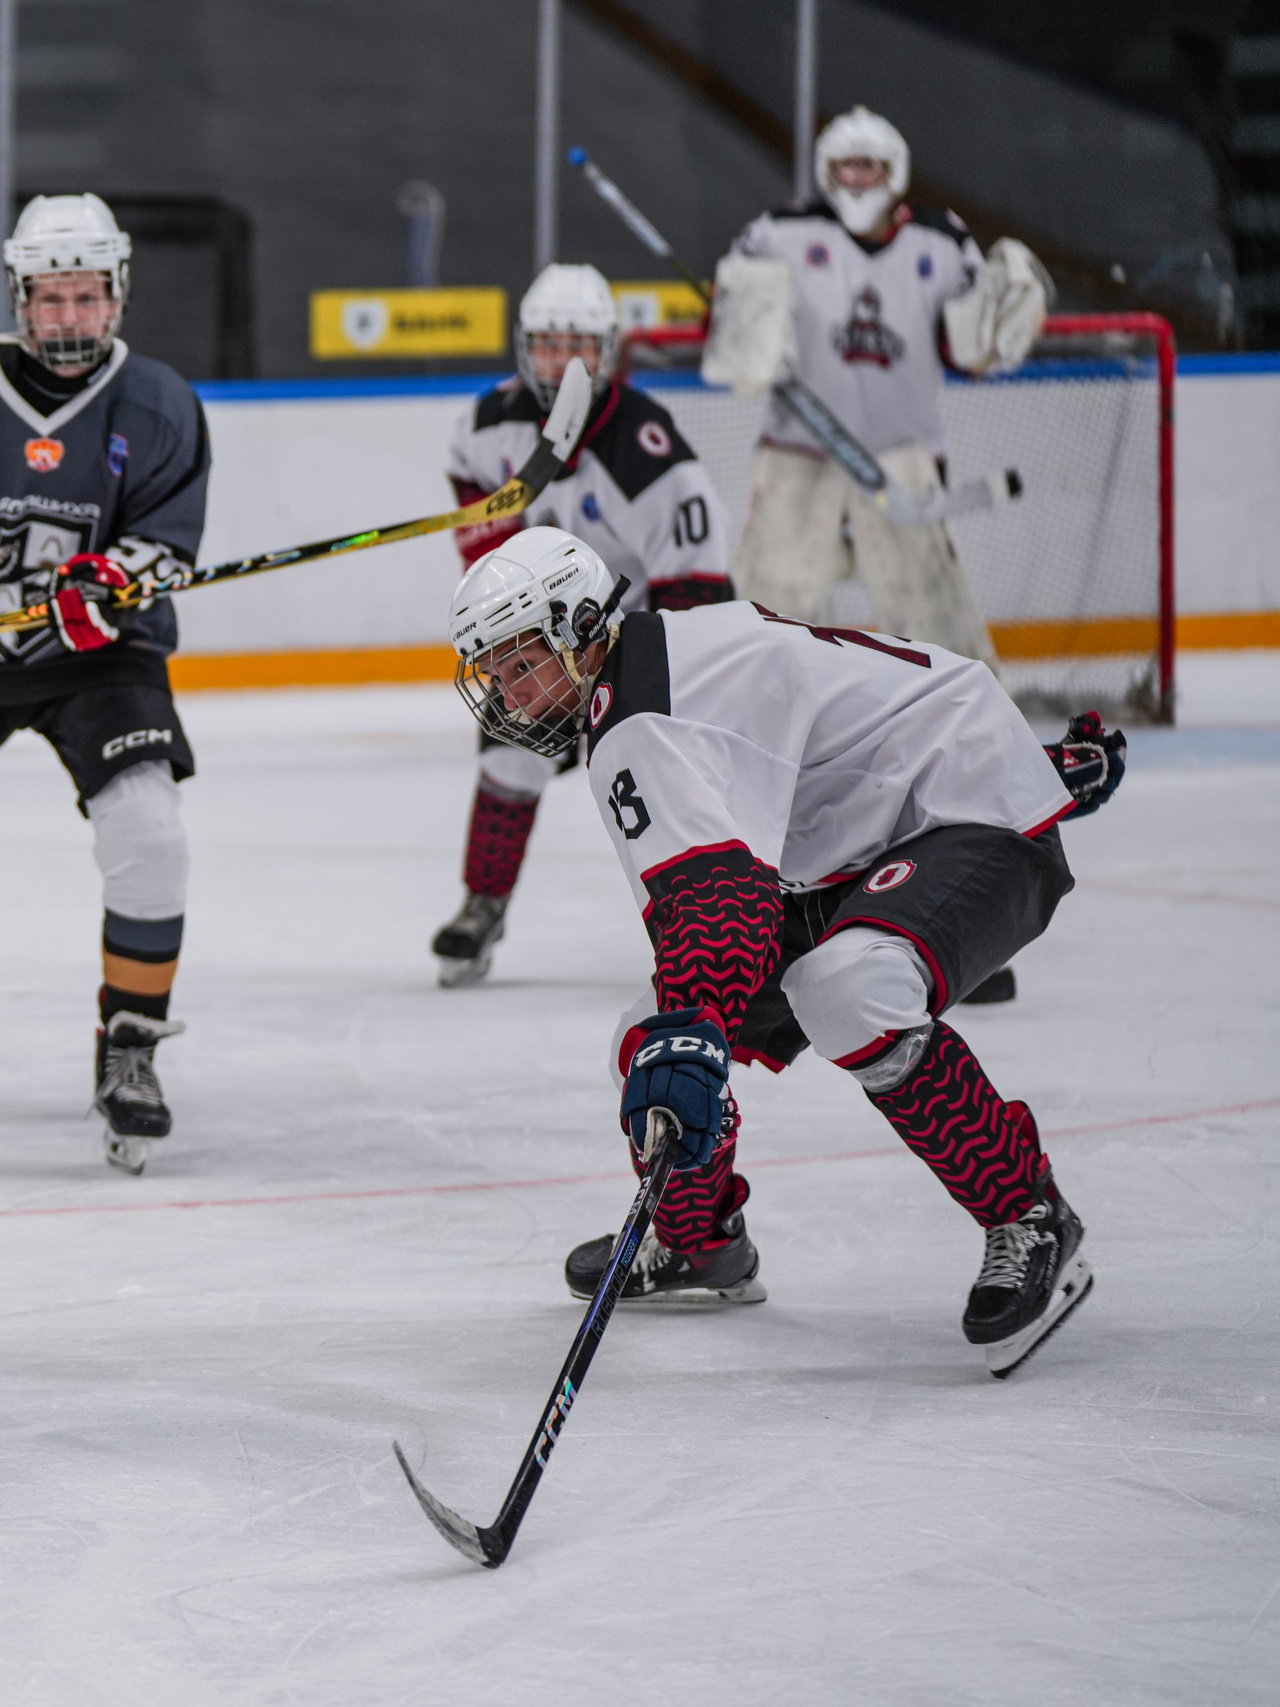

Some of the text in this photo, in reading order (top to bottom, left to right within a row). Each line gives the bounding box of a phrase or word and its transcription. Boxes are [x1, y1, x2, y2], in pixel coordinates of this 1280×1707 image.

[102, 728, 172, 760] CCM
[635, 1036, 726, 1067] CCM
[533, 1375, 578, 1472] CCM
